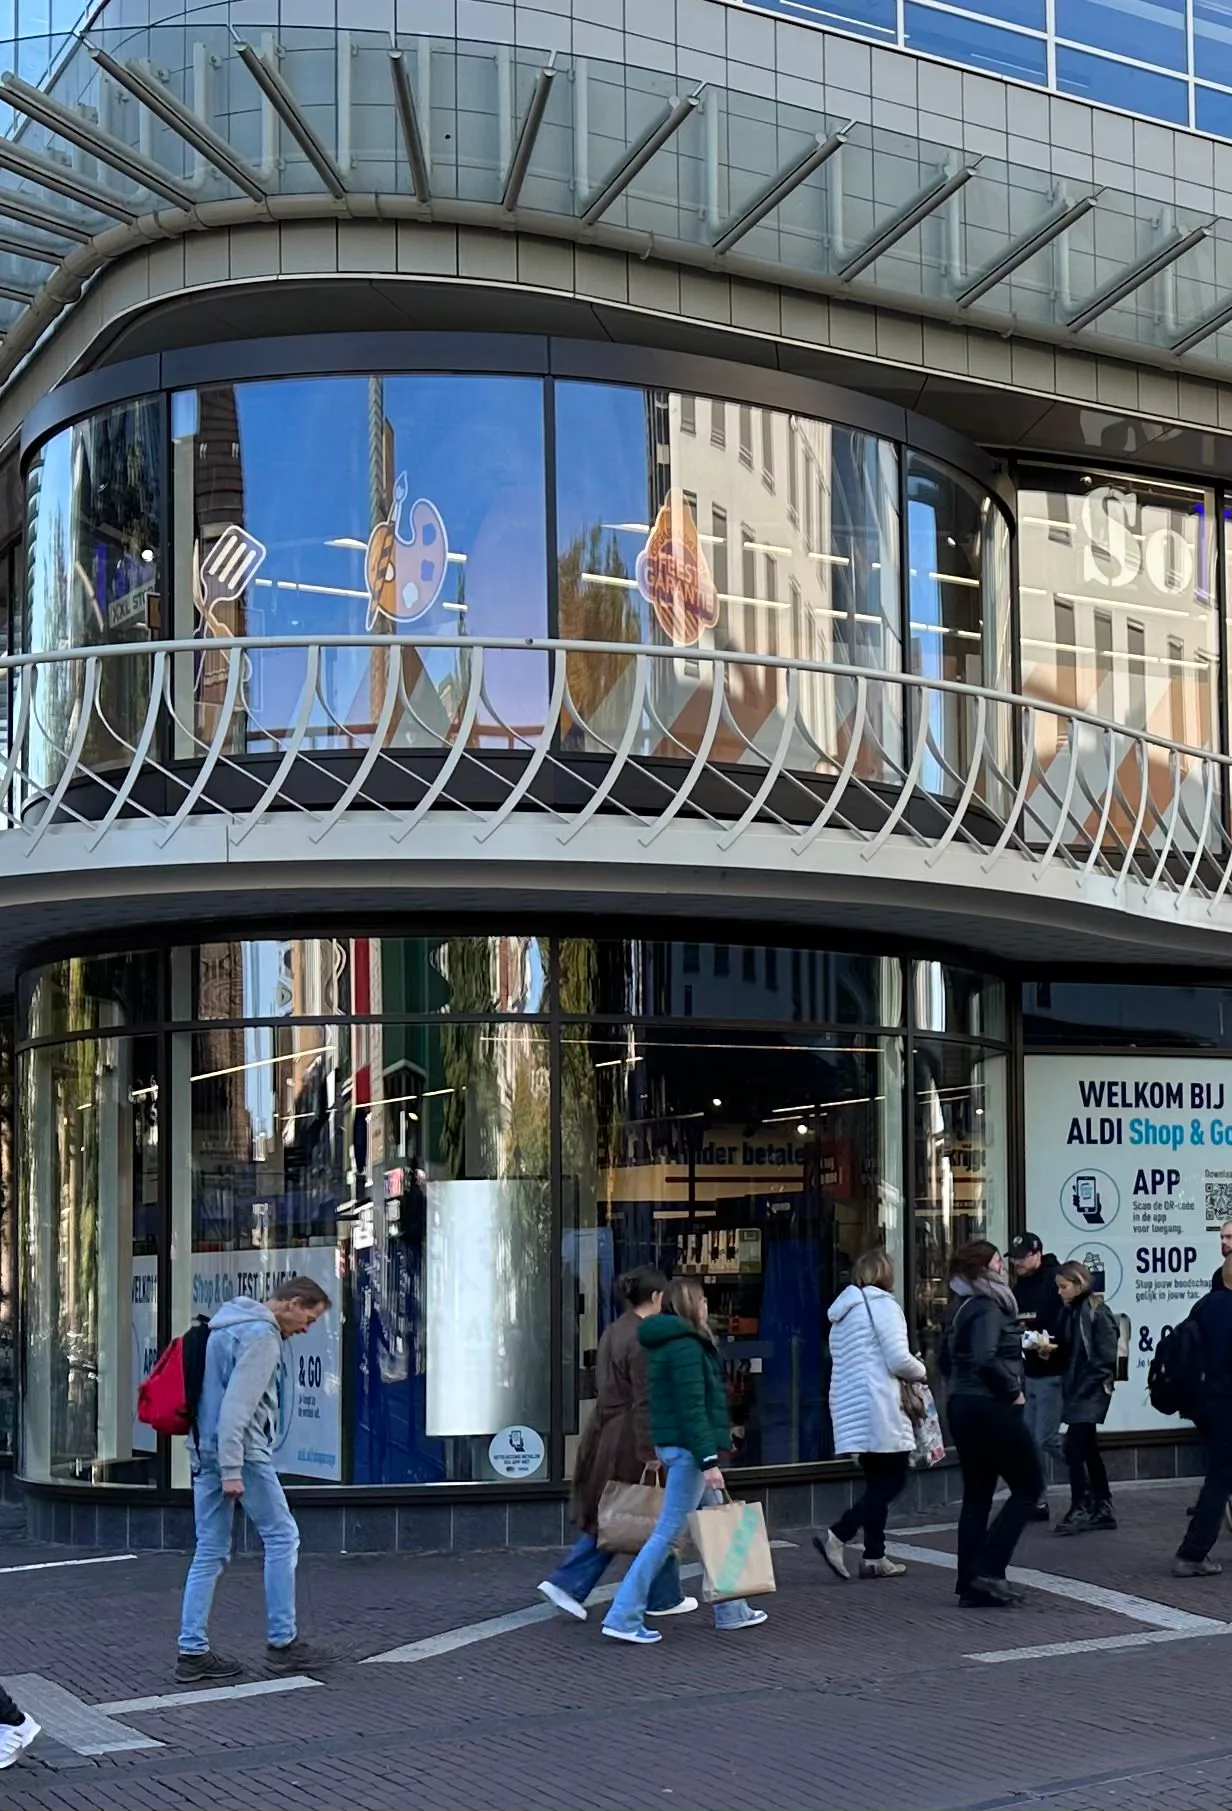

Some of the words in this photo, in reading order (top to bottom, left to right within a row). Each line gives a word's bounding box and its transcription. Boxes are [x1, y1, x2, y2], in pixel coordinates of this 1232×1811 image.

[1078, 1080, 1184, 1109] WELKOM
[1190, 1082, 1225, 1110] BIJ
[1066, 1117, 1123, 1145] ALDI
[1129, 1117, 1185, 1151] Shop
[1190, 1118, 1205, 1146] &
[1132, 1168, 1181, 1195] APP
[1132, 1201, 1151, 1211] Scan
[1153, 1201, 1162, 1210] de
[1133, 1212, 1141, 1221] in
[1142, 1212, 1151, 1221] de
[1153, 1213, 1167, 1224] app
[1152, 1224, 1184, 1235] toegang.
[1136, 1246, 1197, 1274] SHOP
[237, 1271, 258, 1300] TEST
[1138, 1325, 1154, 1352] &
[298, 1355, 306, 1388] &
[308, 1355, 322, 1388] GO
